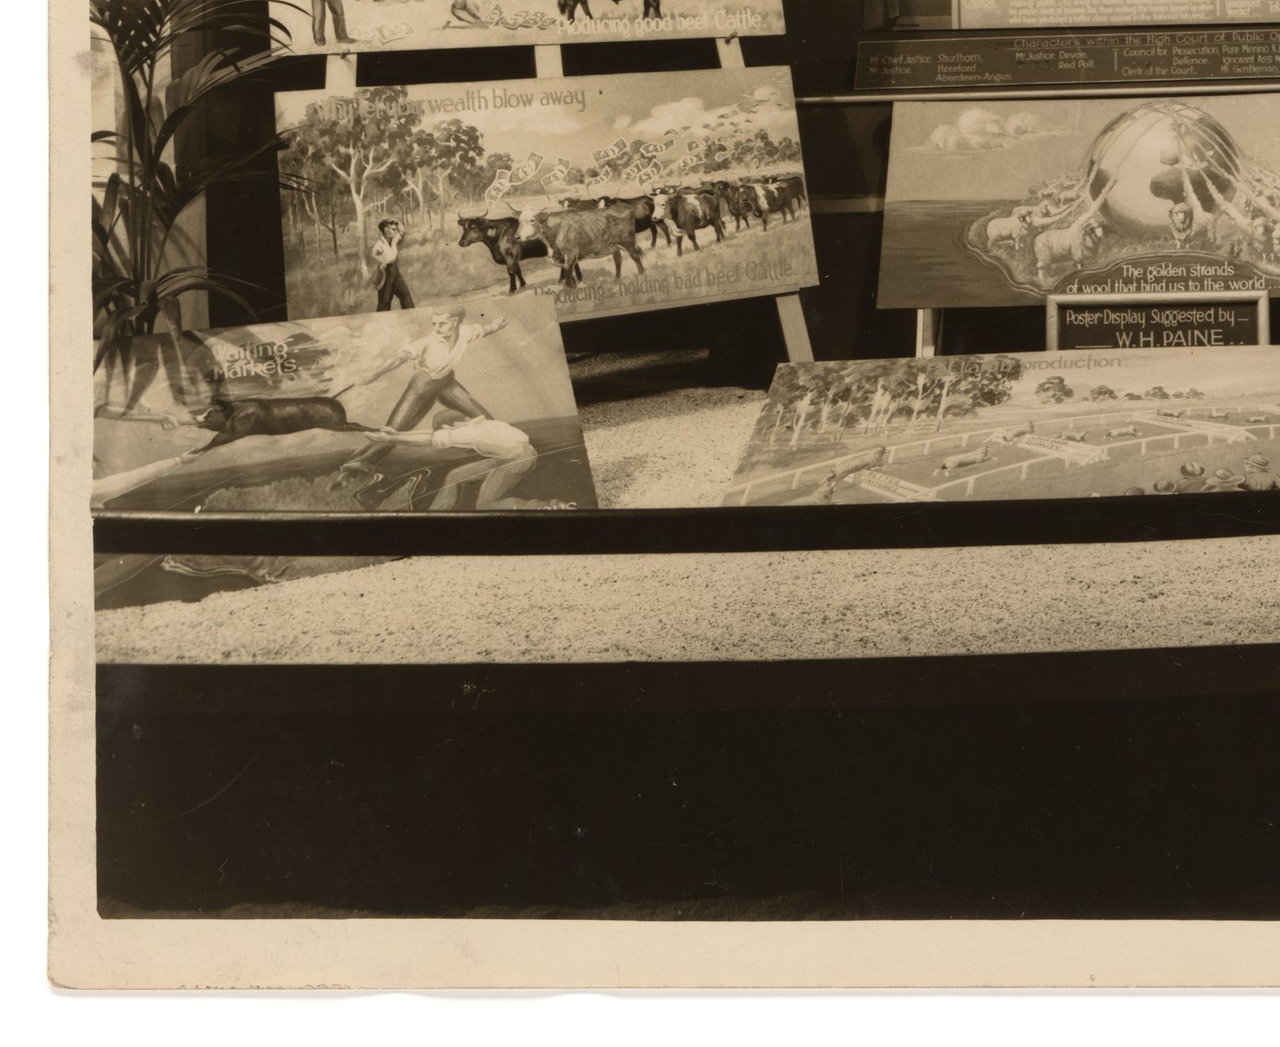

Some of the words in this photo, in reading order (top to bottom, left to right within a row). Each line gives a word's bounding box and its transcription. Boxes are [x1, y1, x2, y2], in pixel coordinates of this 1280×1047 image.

[557, 15, 630, 38] Producing
[634, 13, 671, 37] good
[676, 12, 707, 31] beef
[714, 8, 767, 29] Cattle.
[1086, 35, 1119, 46] within
[1125, 33, 1142, 45] the
[1146, 33, 1170, 47] High
[1175, 33, 1208, 44] Court
[1214, 32, 1225, 42] of
[1232, 31, 1264, 43] Public
[1156, 46, 1167, 56] for
[1222, 45, 1240, 54] Pure
[1242, 44, 1269, 53] Merino
[1058, 60, 1076, 69] Red
[1256, 54, 1273, 63] Ass
[1121, 66, 1144, 76] Clerk
[1144, 65, 1154, 75] of
[1155, 64, 1168, 75] the
[1232, 63, 1278, 73] Gentleman
[427, 90, 489, 115] wealth
[491, 87, 534, 110] blow
[539, 88, 586, 113] away
[1122, 264, 1144, 279] The
[1147, 263, 1187, 281] golden
[1190, 261, 1235, 278] strands
[618, 272, 669, 297] holding
[674, 270, 701, 290] bad
[705, 265, 742, 287] beef
[1066, 278, 1080, 294] of
[1082, 279, 1111, 293] wool
[1114, 278, 1138, 292] that
[1140, 279, 1166, 292] bind
[1168, 280, 1185, 291] us
[1188, 276, 1201, 291] to
[1203, 277, 1225, 291] the
[1150, 308, 1215, 328] Suggested
[1218, 307, 1236, 327] by
[1021, 354, 1122, 371] production
